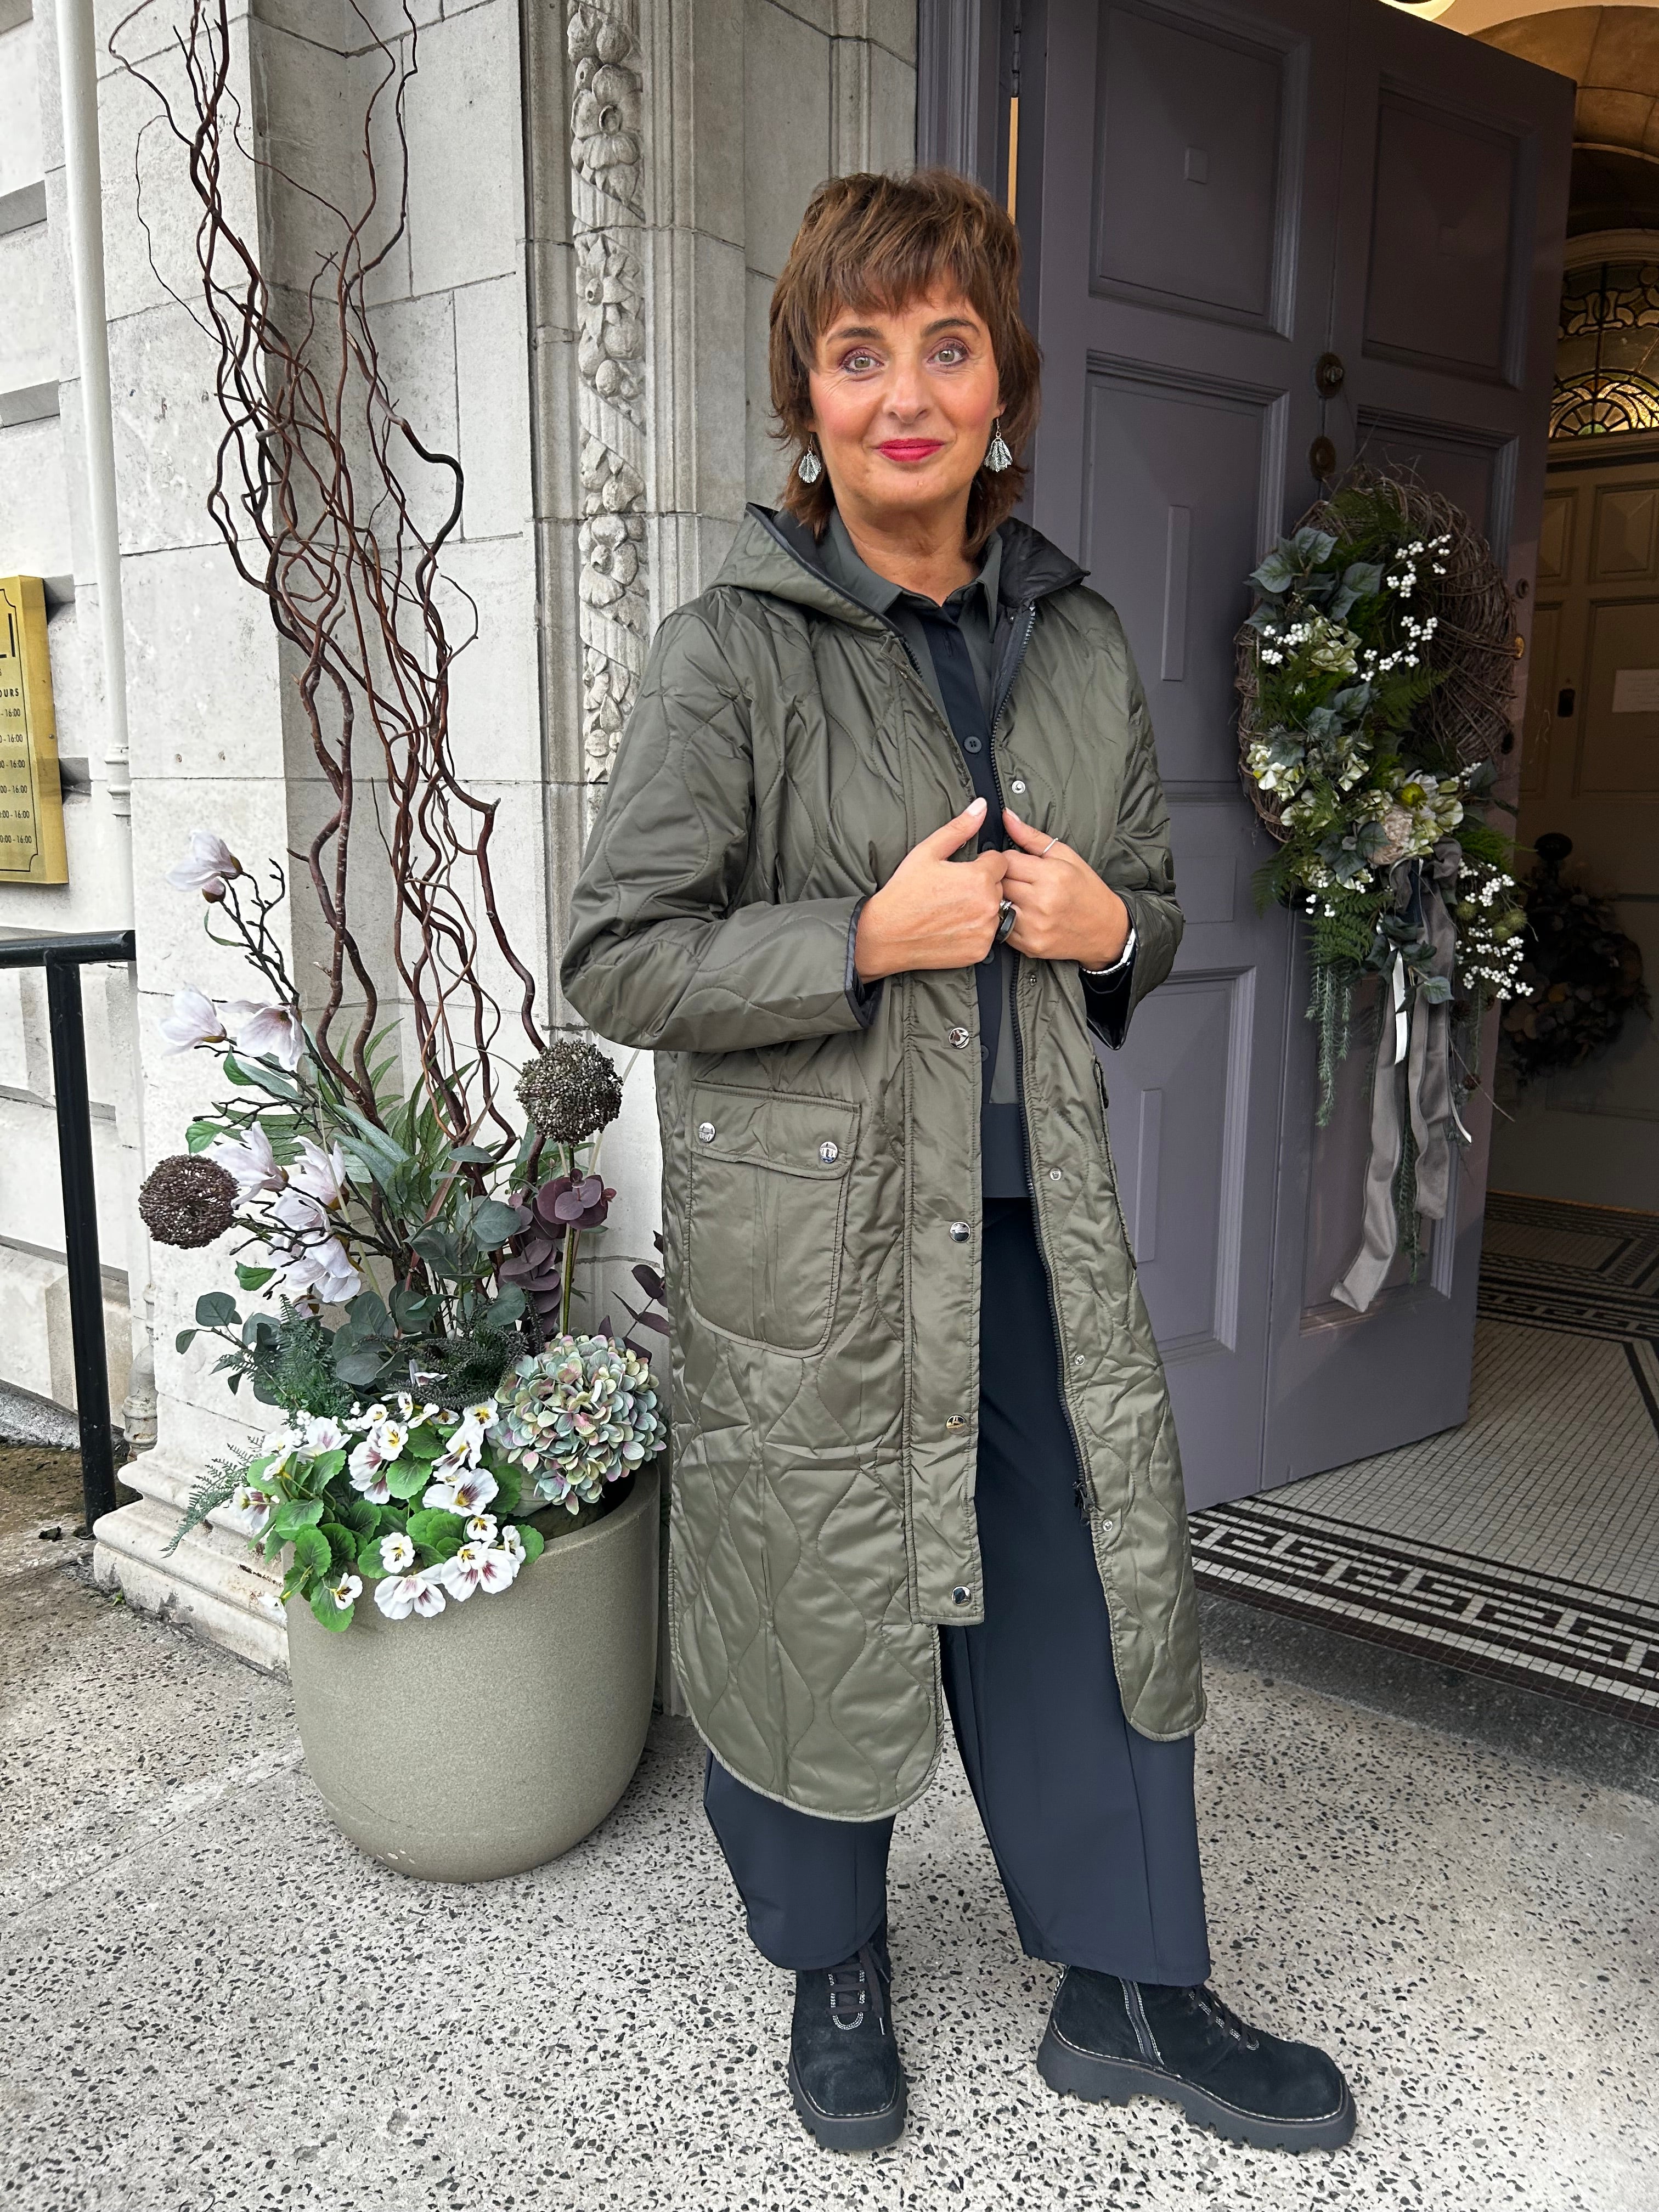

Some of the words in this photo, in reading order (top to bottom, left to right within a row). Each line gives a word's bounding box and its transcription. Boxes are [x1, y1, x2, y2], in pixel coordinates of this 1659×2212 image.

[5, 708, 20, 717] 16:00
[7, 734, 23, 743] 16:00
[10, 760, 25, 768] 16:00
[13, 785, 27, 793] 16:00
[14, 810, 30, 819] 16:00
[17, 835, 32, 844] 16:00
